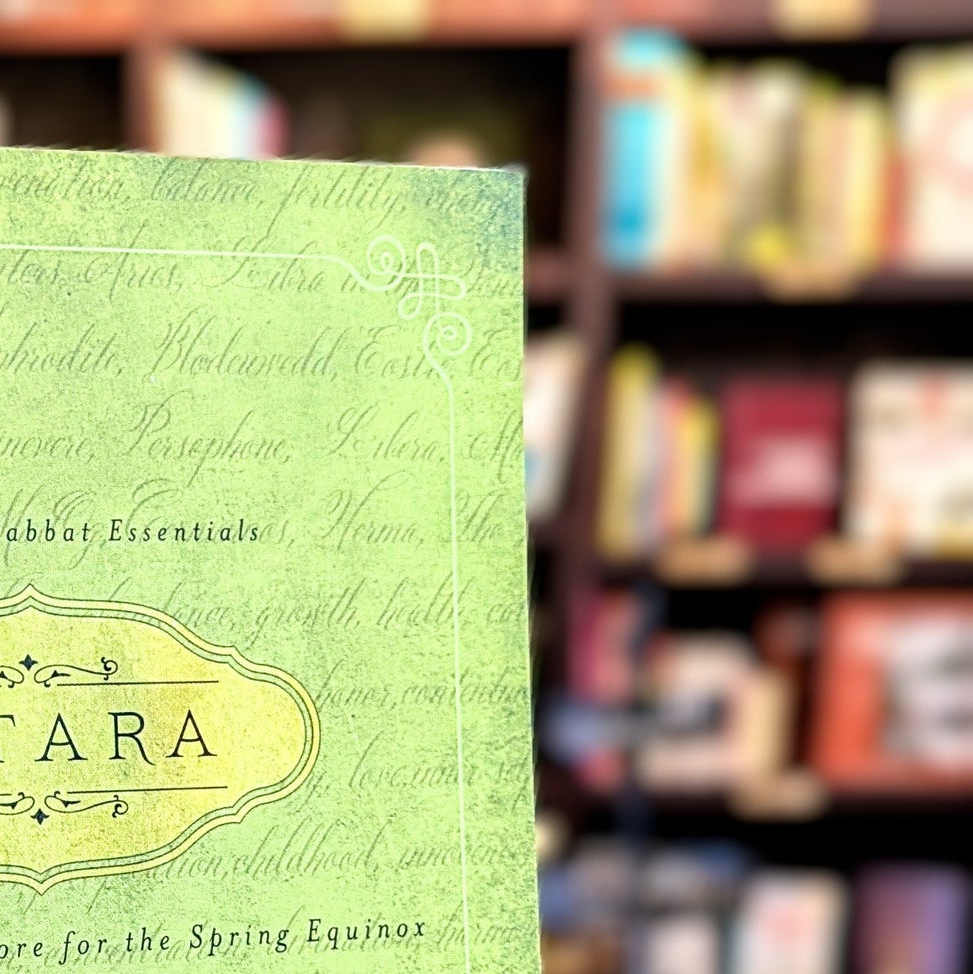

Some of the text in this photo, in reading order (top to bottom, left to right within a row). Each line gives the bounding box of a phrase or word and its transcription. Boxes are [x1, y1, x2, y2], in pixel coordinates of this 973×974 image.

[123, 391, 292, 487] Persephone,
[109, 517, 259, 543] Essentials
[57, 929, 108, 968] for
[125, 926, 171, 953] the
[188, 922, 290, 958] Spring
[306, 918, 426, 951] Equinox
